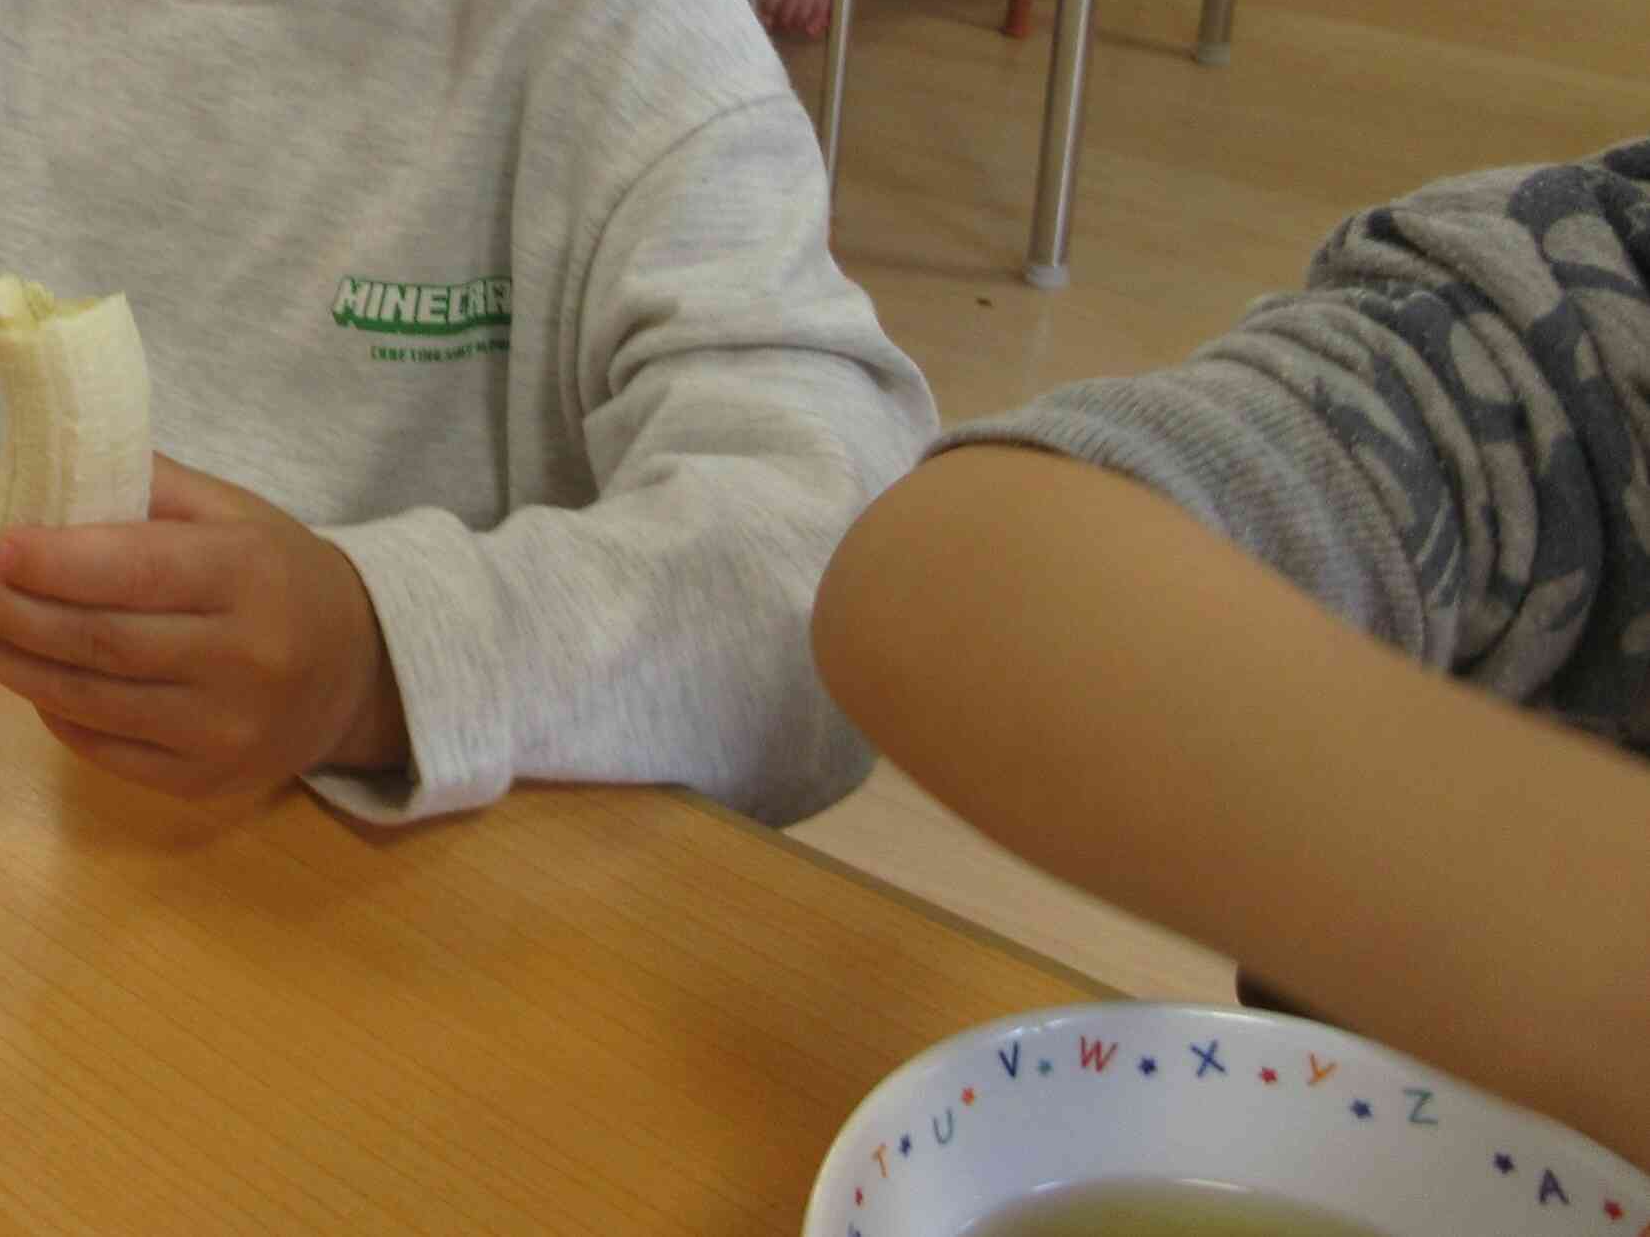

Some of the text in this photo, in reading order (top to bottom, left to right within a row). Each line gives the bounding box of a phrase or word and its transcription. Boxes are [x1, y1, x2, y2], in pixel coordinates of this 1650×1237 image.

[870, 1036, 1570, 1207] T U V W X Y Z A
